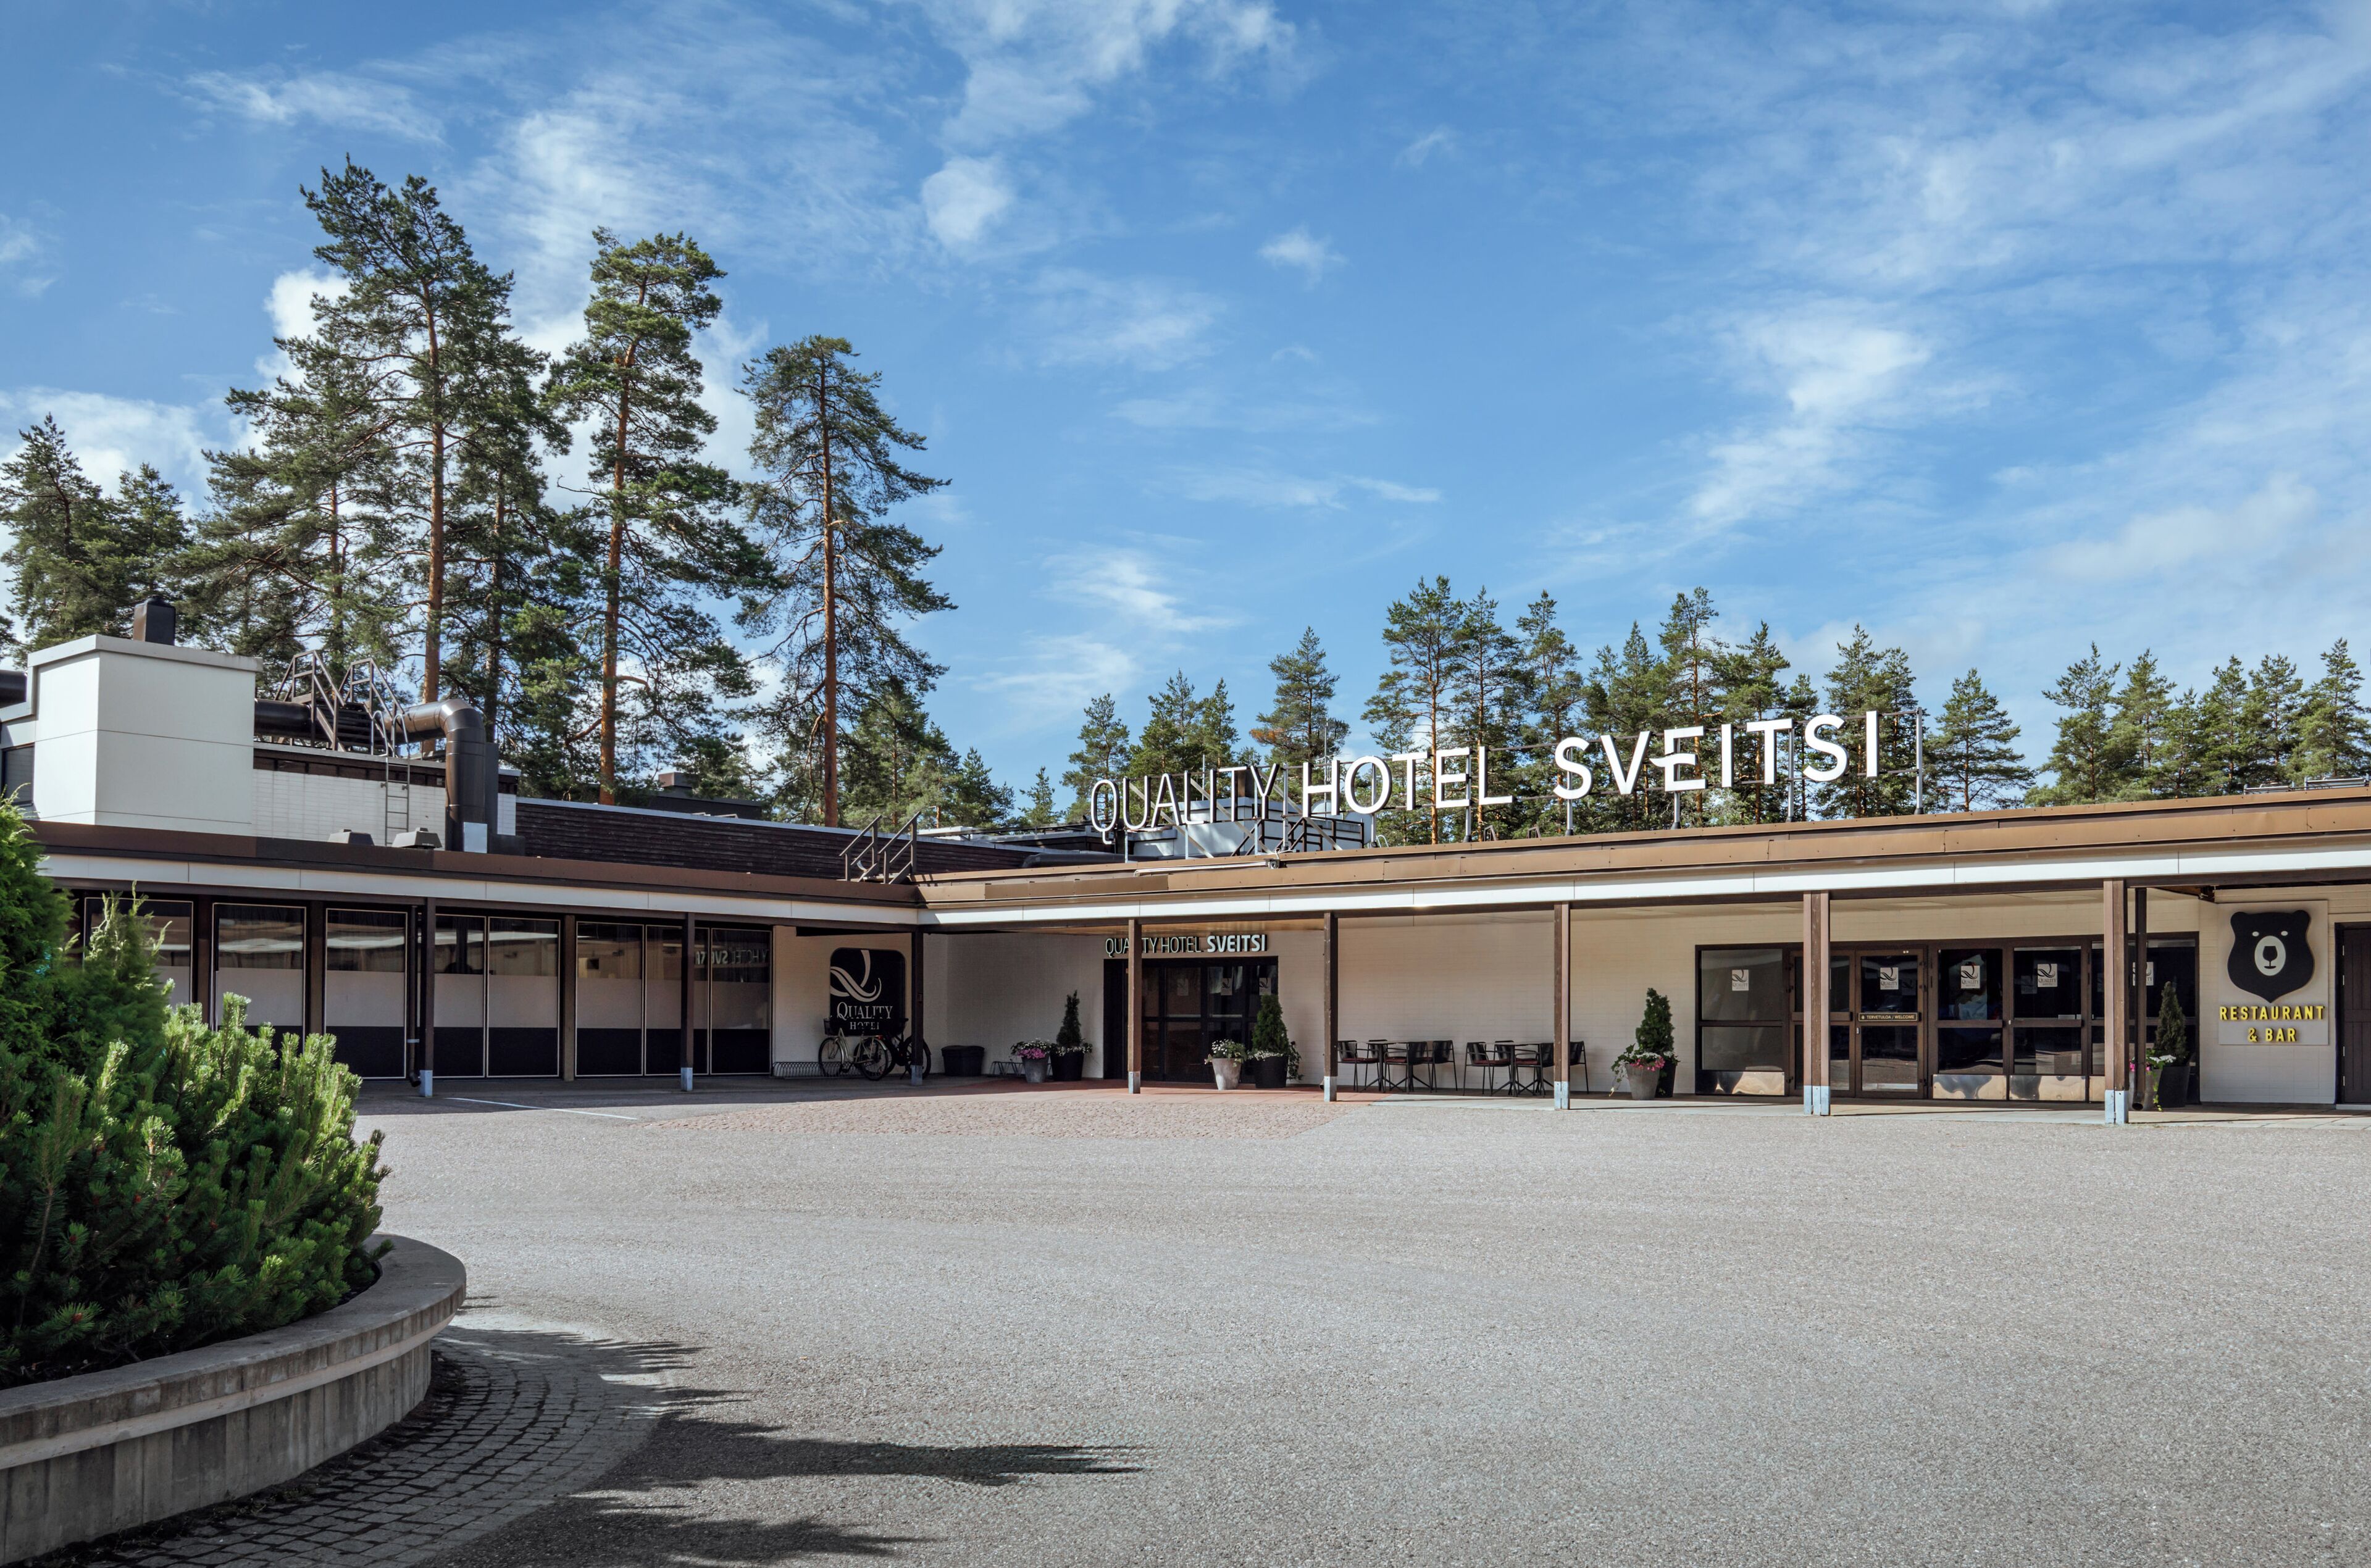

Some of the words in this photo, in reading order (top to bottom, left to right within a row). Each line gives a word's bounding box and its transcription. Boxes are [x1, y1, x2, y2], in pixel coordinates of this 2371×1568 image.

[1090, 763, 1279, 844] QUALITY
[1302, 746, 1513, 817] HOTEL
[1552, 710, 1879, 800] SVEITSI
[1105, 937, 1158, 957] QUATY
[1161, 935, 1202, 953] HOTEL
[1206, 933, 1266, 953] SVEITSI
[837, 1001, 893, 1020] QUALITY
[2219, 1006, 2325, 1020] RESTAURANT
[2248, 1027, 2258, 1042] &
[2265, 1027, 2296, 1042] BAR
